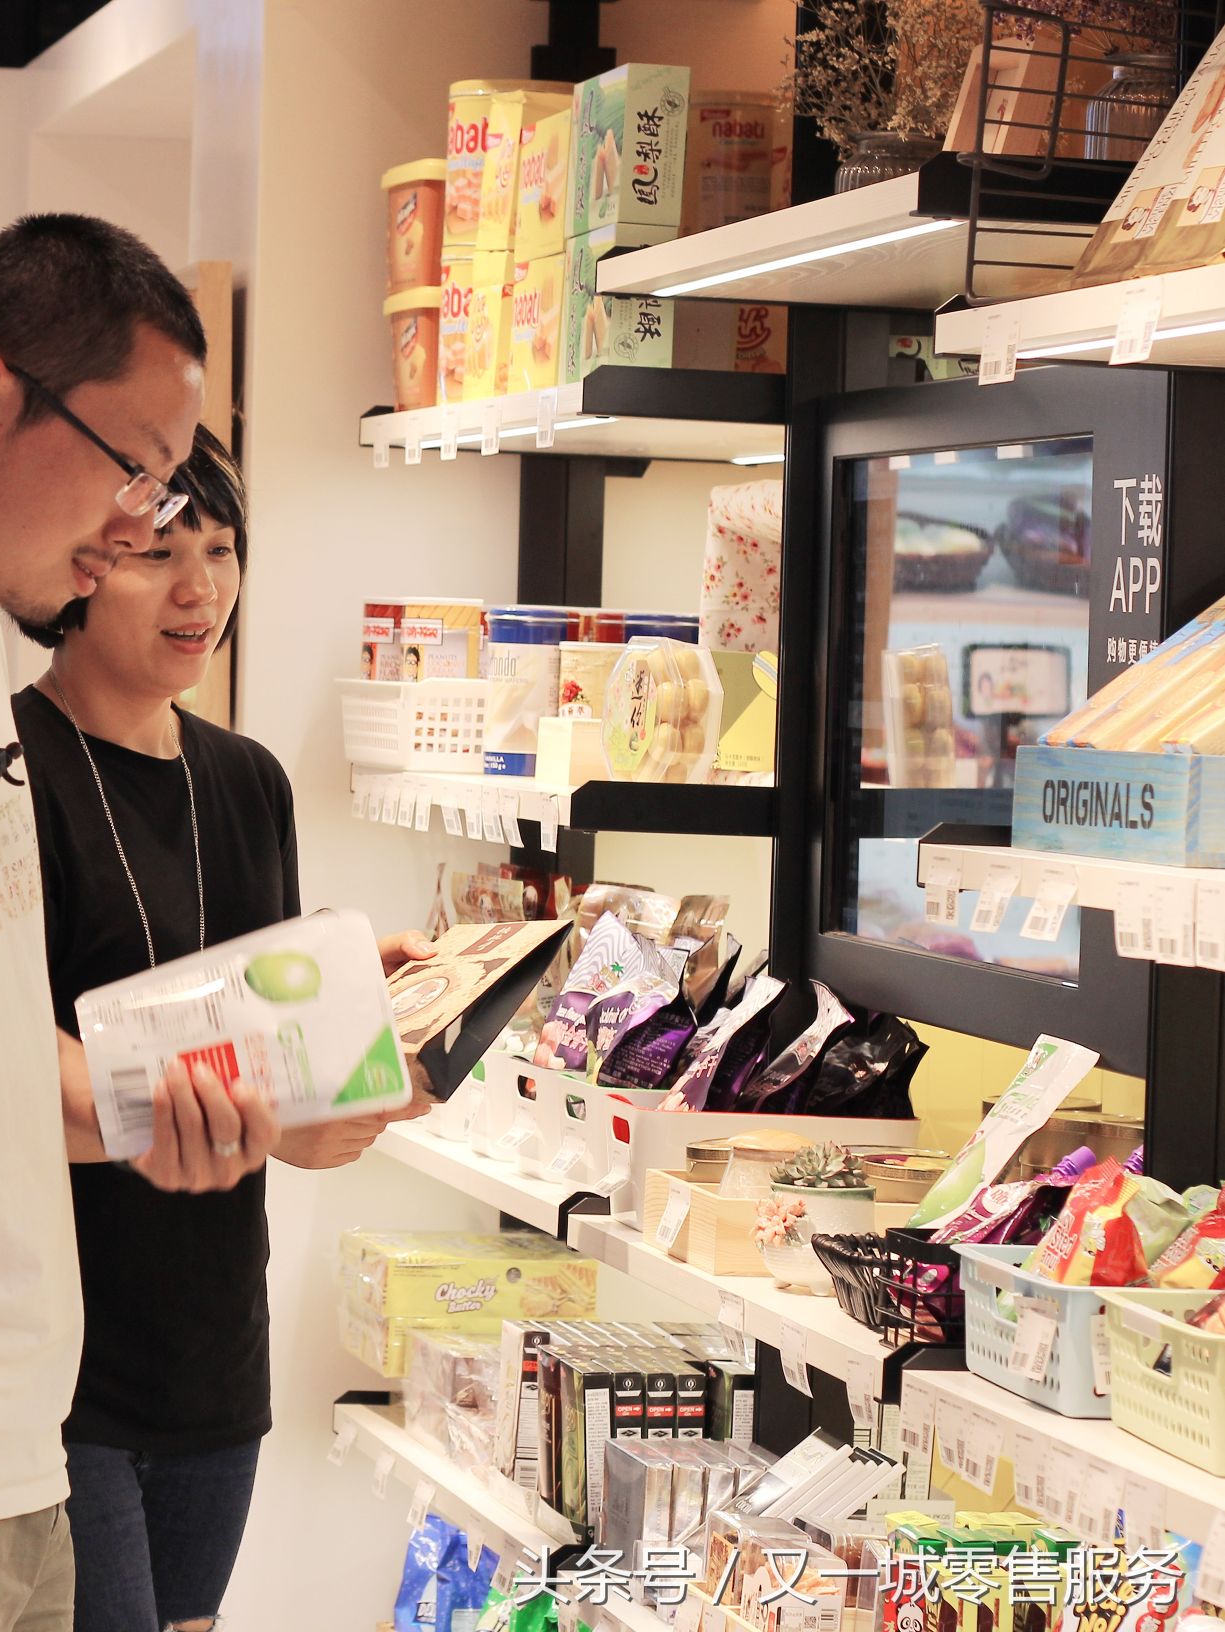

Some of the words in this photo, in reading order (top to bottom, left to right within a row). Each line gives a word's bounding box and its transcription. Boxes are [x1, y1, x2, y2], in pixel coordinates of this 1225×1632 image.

[712, 119, 765, 139] nabati
[1113, 474, 1163, 547] 下载
[1109, 556, 1161, 614] APP
[1042, 778, 1156, 830] ORIGINALS
[435, 1278, 498, 1301] Chocky
[447, 1300, 483, 1313] Butter
[617, 1405, 633, 1413] OPEN
[649, 1405, 665, 1413] OPEN
[679, 1405, 695, 1413] OPEN
